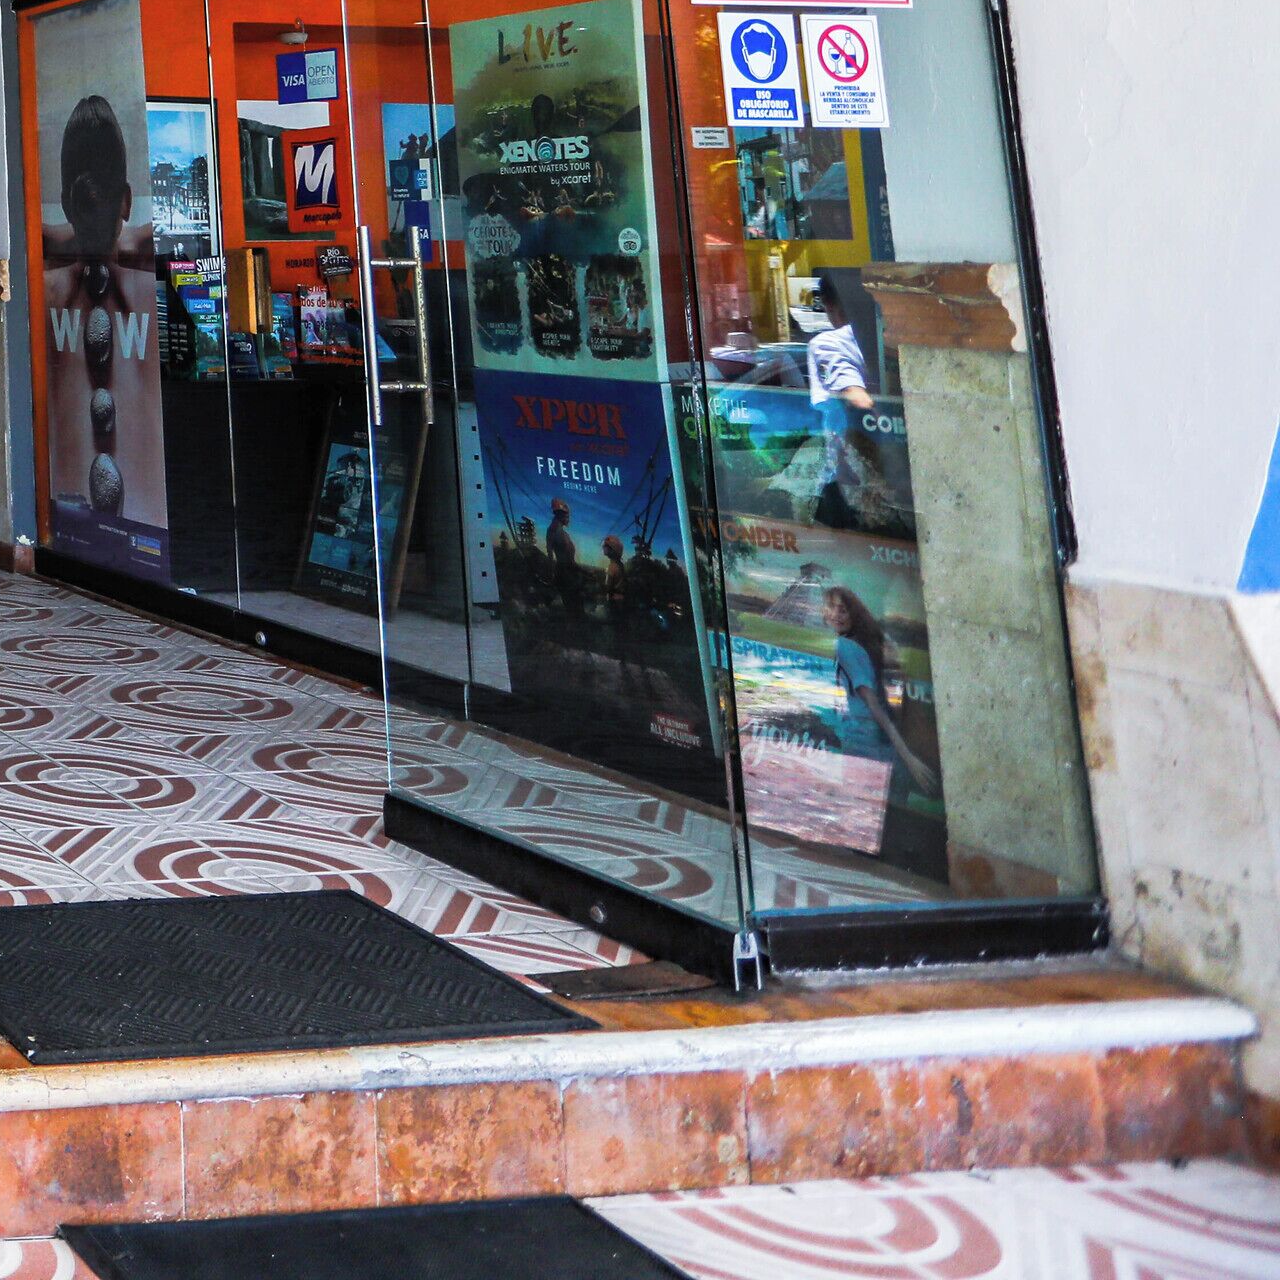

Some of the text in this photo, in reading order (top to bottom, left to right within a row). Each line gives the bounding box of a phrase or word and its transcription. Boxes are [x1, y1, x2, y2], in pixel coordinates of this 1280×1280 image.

[308, 65, 335, 77] OPEN
[282, 74, 305, 87] VISA
[308, 77, 334, 86] ABIERTO
[755, 90, 772, 100] USO
[740, 99, 789, 109] OBLIGATORIO
[737, 108, 794, 119] DE MASCARILLA
[500, 162, 590, 175] ENIGMATIC WATERS TOUR
[550, 171, 591, 187] by xcaret
[512, 395, 627, 440] XPLOR
[536, 456, 621, 486] FREEDOM
